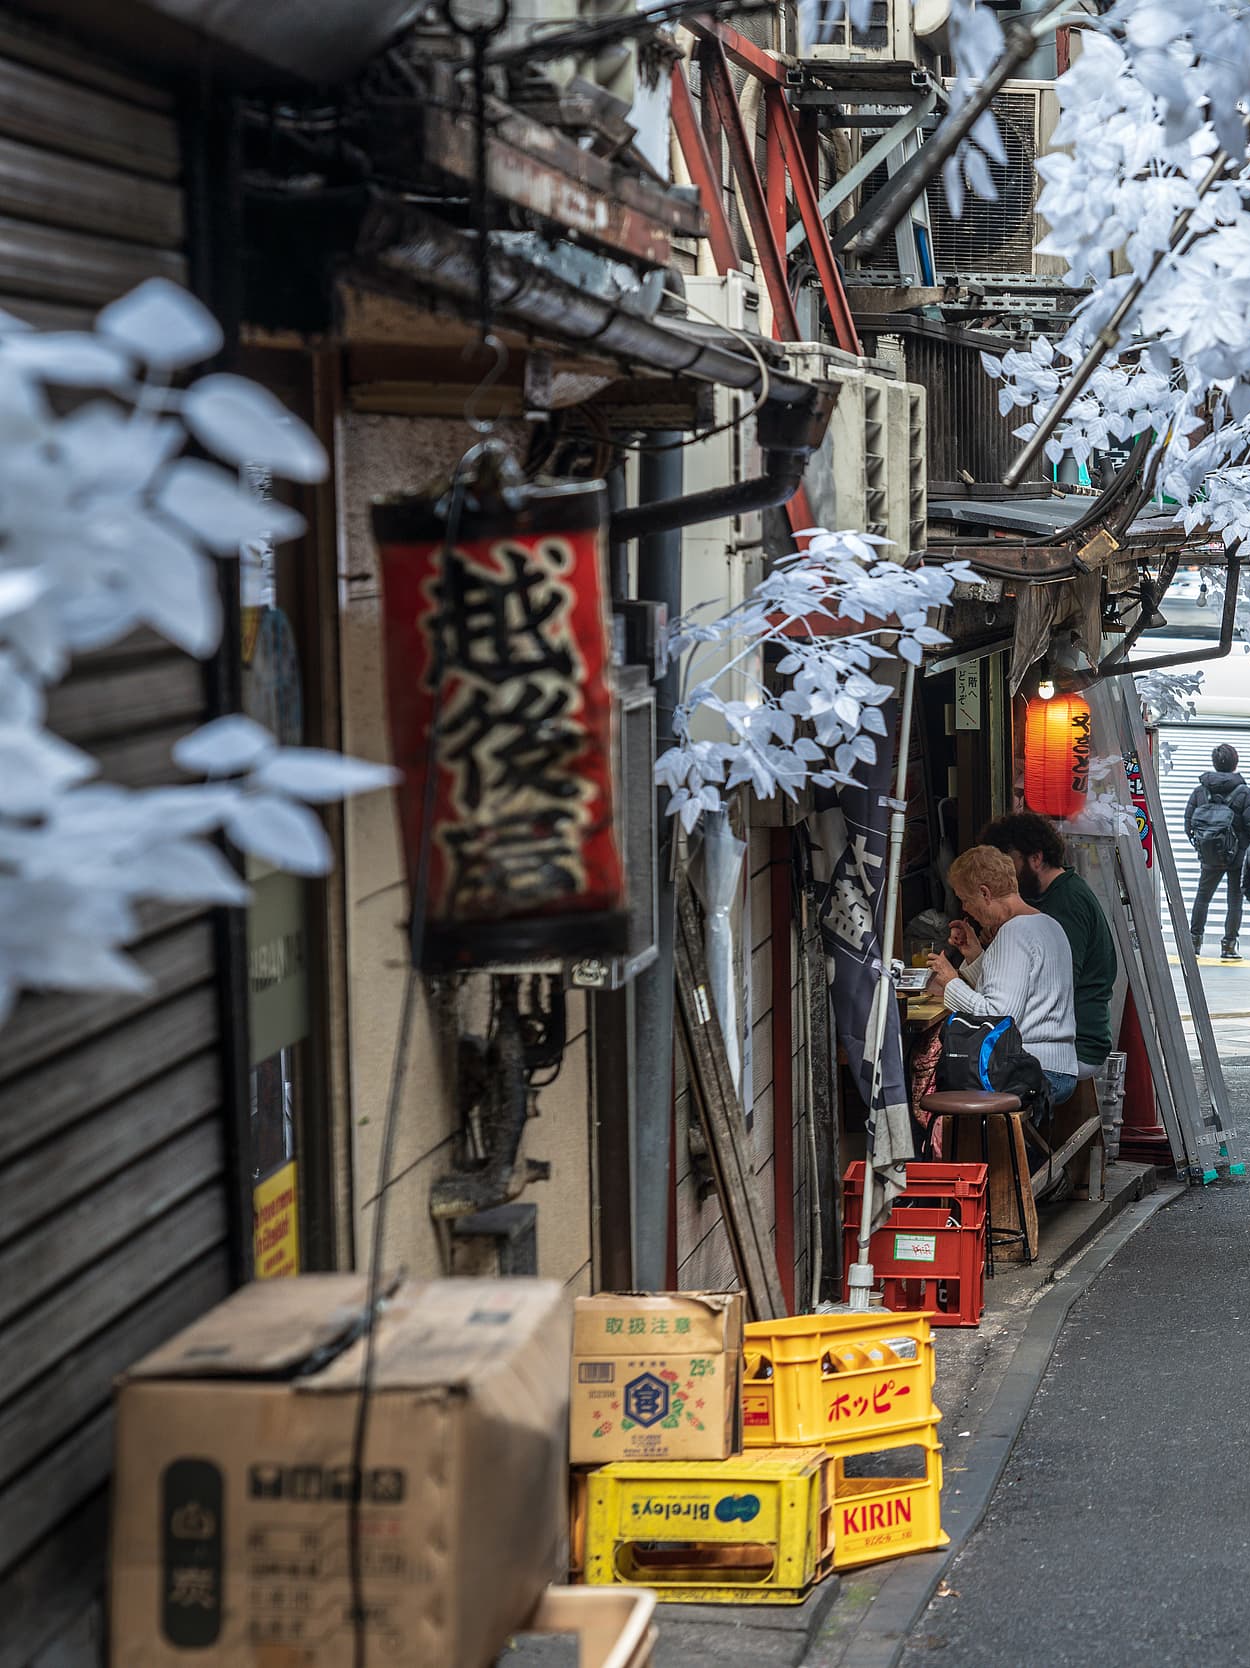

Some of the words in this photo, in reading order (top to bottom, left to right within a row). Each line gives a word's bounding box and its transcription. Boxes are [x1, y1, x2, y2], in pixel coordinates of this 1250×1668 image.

[958, 671, 966, 705] どうぞ
[822, 833, 884, 951] 大盛
[605, 1317, 692, 1335] 取扱注意
[689, 1359, 716, 1377] 25%
[828, 1380, 911, 1422] ホッピー
[632, 1501, 710, 1520] Bireley's
[843, 1496, 912, 1536] KIRIN
